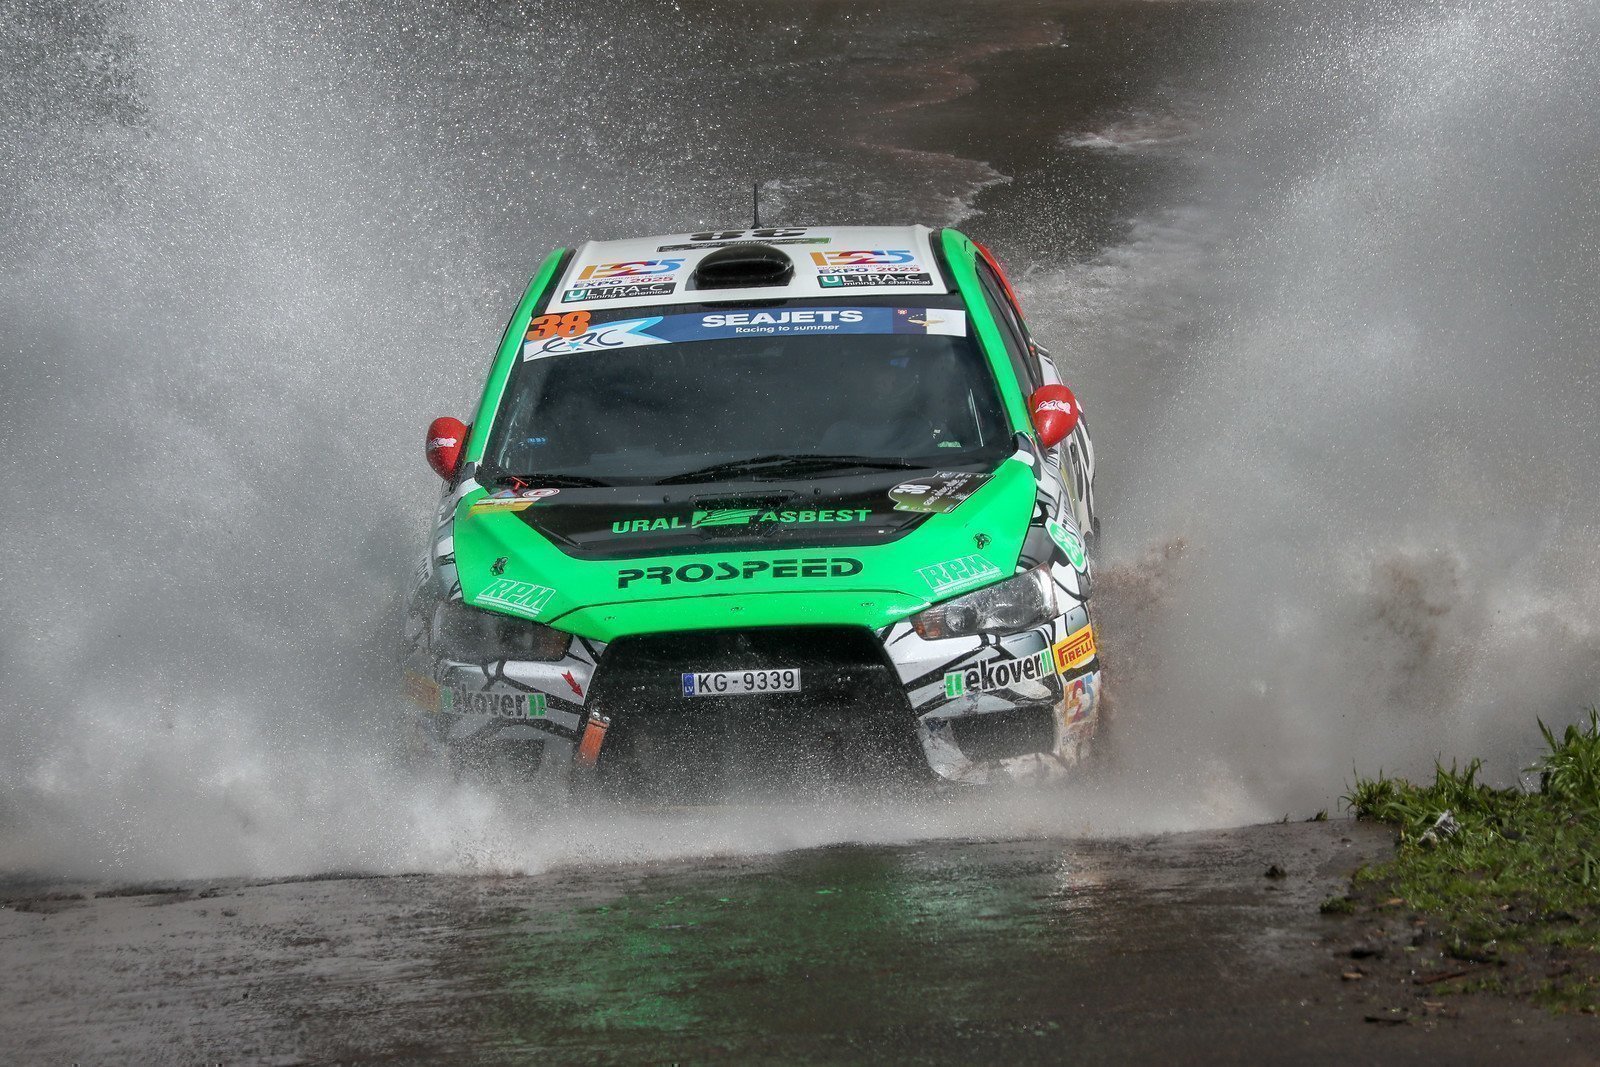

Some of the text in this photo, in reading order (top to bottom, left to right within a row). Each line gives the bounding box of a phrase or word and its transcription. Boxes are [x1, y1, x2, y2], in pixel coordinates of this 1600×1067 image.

[573, 280, 622, 289] EXPO
[630, 276, 674, 284] 2025
[819, 267, 869, 275] EXPO
[585, 292, 617, 300] mining
[629, 289, 672, 297] chemical
[526, 310, 592, 341] 38
[702, 311, 864, 328] SEAJETS
[735, 326, 775, 334] Racing
[612, 509, 872, 534] URAL ASBEST
[617, 557, 864, 589] PROSPEED
[914, 554, 1000, 588] RPM
[479, 578, 556, 612] RPM
[1057, 632, 1093, 668] PIRELLI
[965, 654, 1042, 691] ekover
